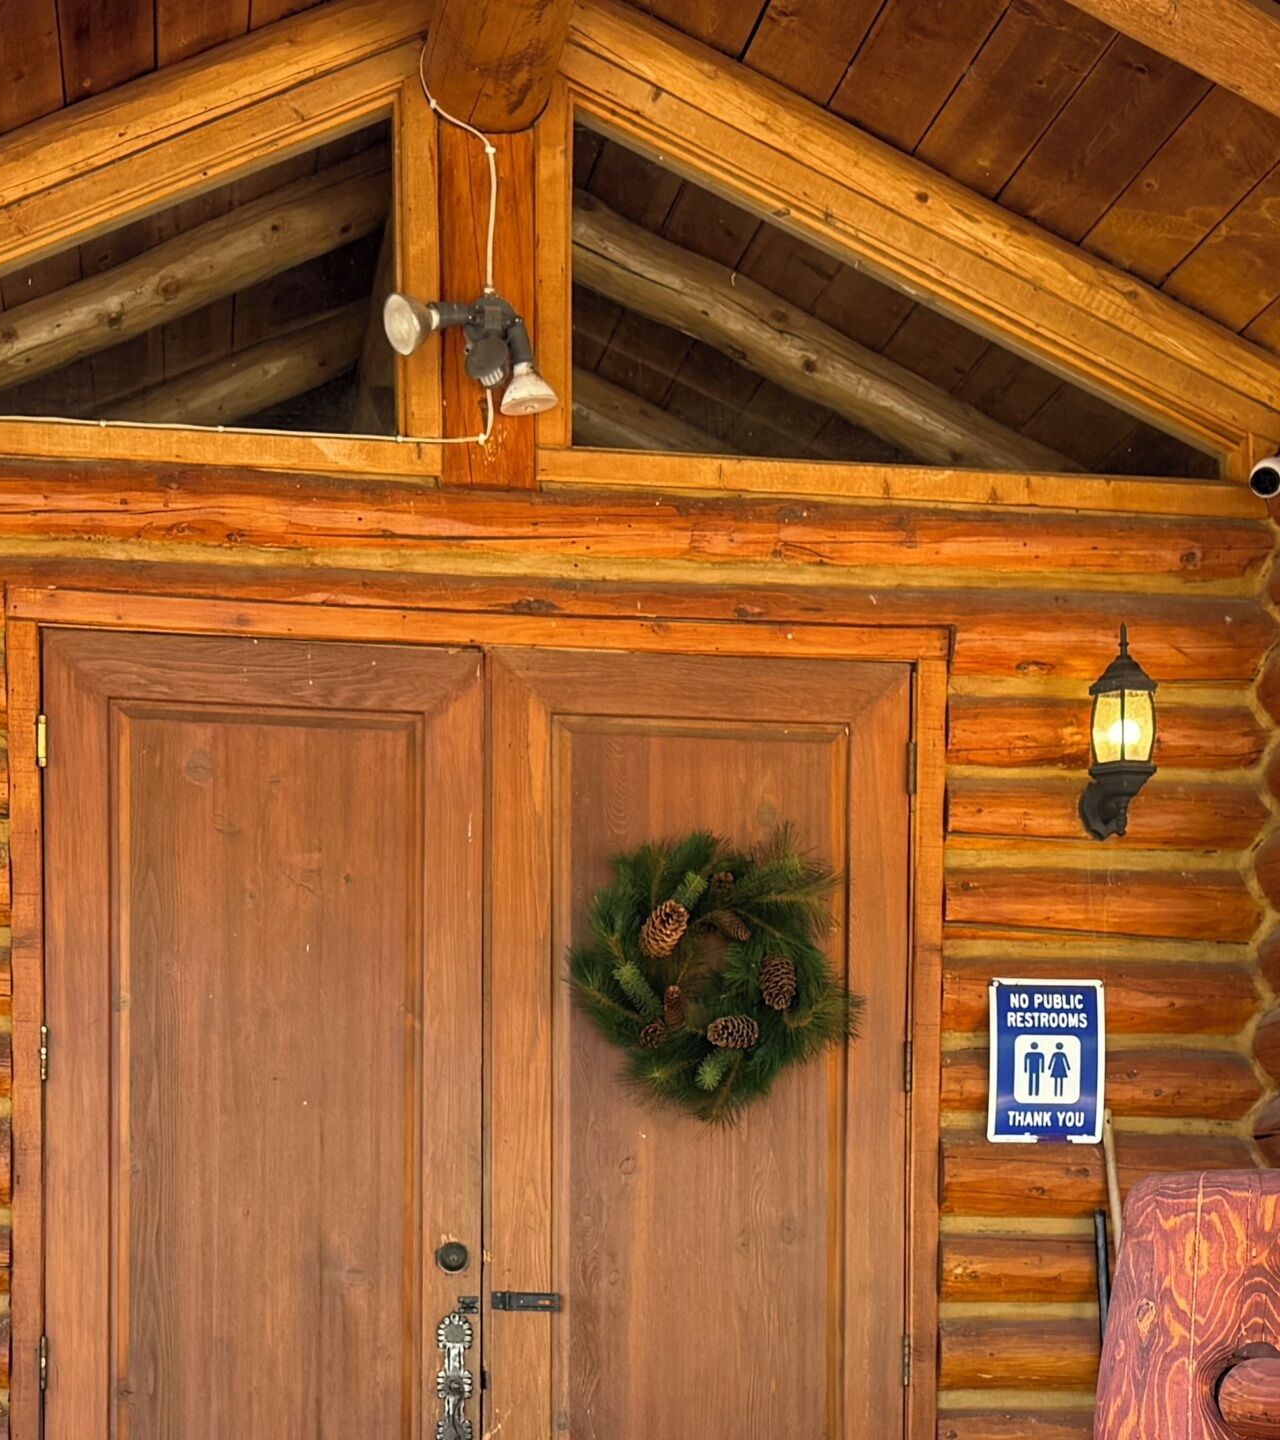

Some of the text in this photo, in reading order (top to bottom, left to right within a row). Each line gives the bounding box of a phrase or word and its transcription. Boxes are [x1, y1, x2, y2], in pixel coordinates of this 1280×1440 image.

[1009, 993, 1084, 1009] NO PUBLIC
[1007, 1011, 1088, 1028] RESTROOMS
[1008, 1110, 1085, 1127] THANK YOU
